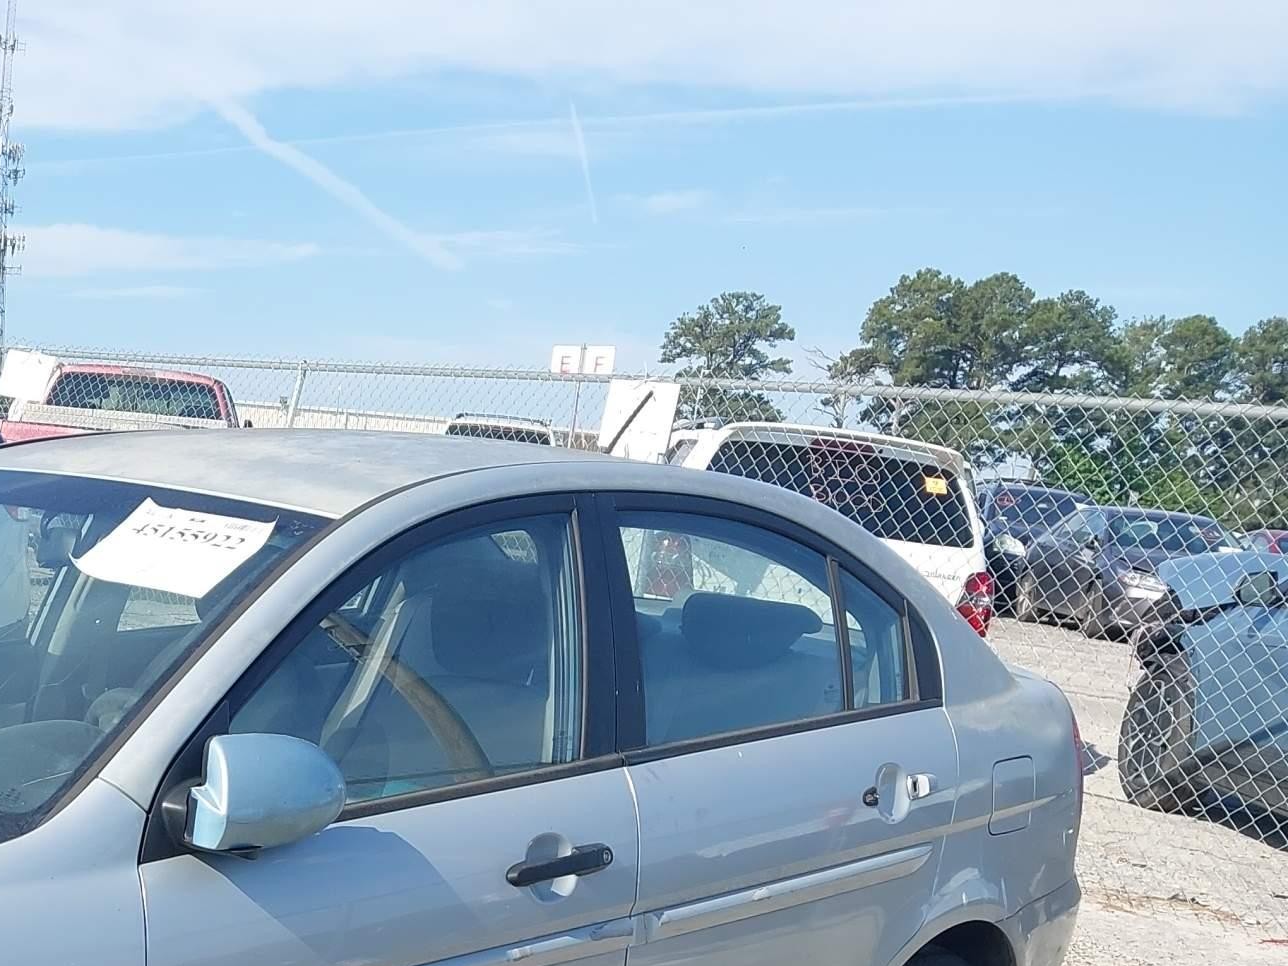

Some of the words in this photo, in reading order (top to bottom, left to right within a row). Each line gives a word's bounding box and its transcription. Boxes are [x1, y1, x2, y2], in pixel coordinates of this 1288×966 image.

[560, 355, 572, 372] E
[594, 356, 606, 372] F
[132, 523, 246, 550] 45155922
